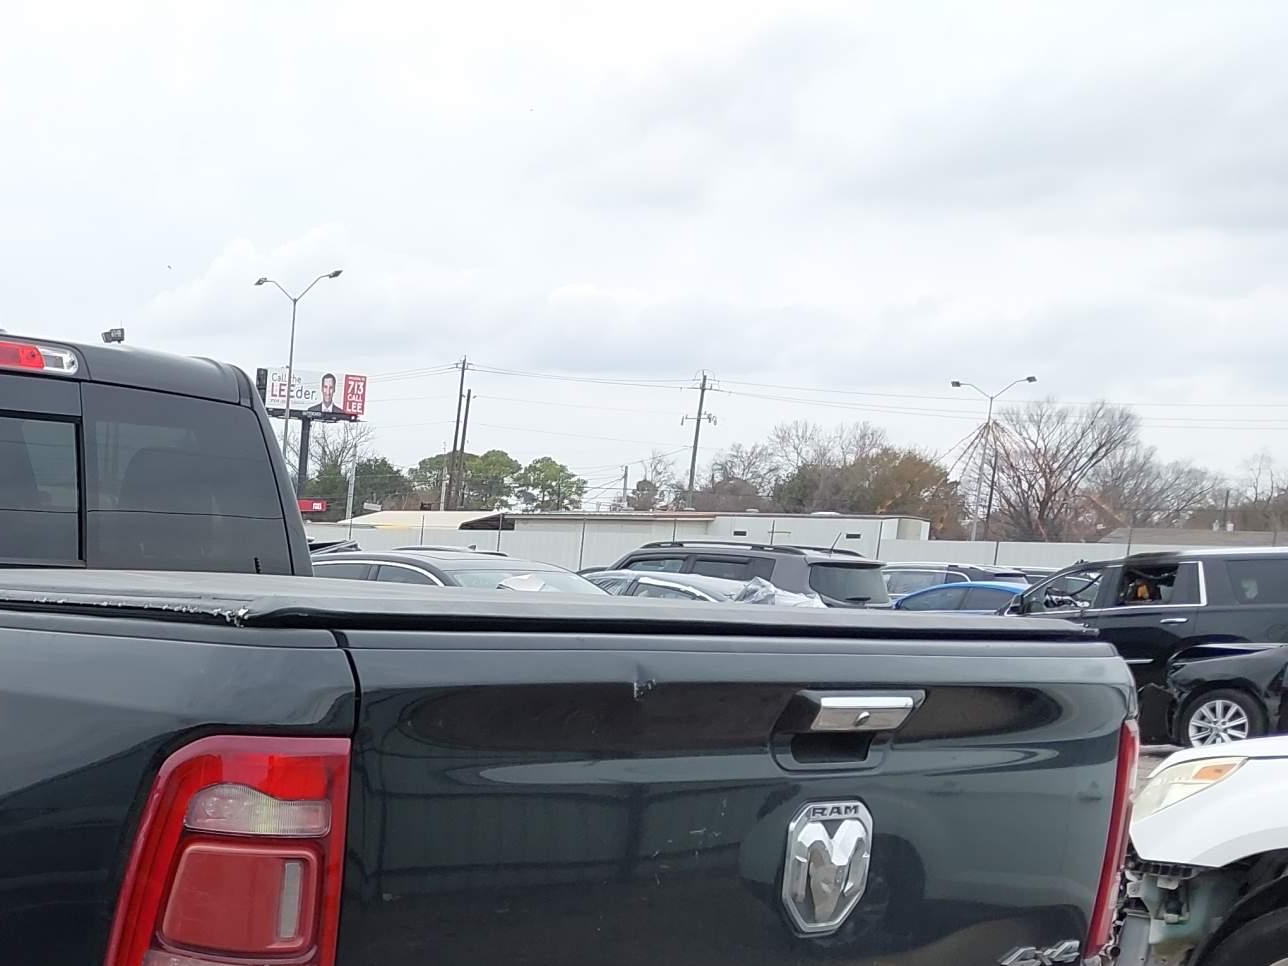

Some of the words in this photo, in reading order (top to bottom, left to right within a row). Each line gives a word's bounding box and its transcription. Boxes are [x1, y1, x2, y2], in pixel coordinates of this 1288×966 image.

[272, 373, 287, 382] Call
[291, 374, 302, 383] he
[271, 382, 318, 401] LEEder.
[347, 380, 365, 394] 713
[347, 394, 363, 402] CALL
[346, 401, 363, 413] LEE
[811, 805, 860, 817] RAM
